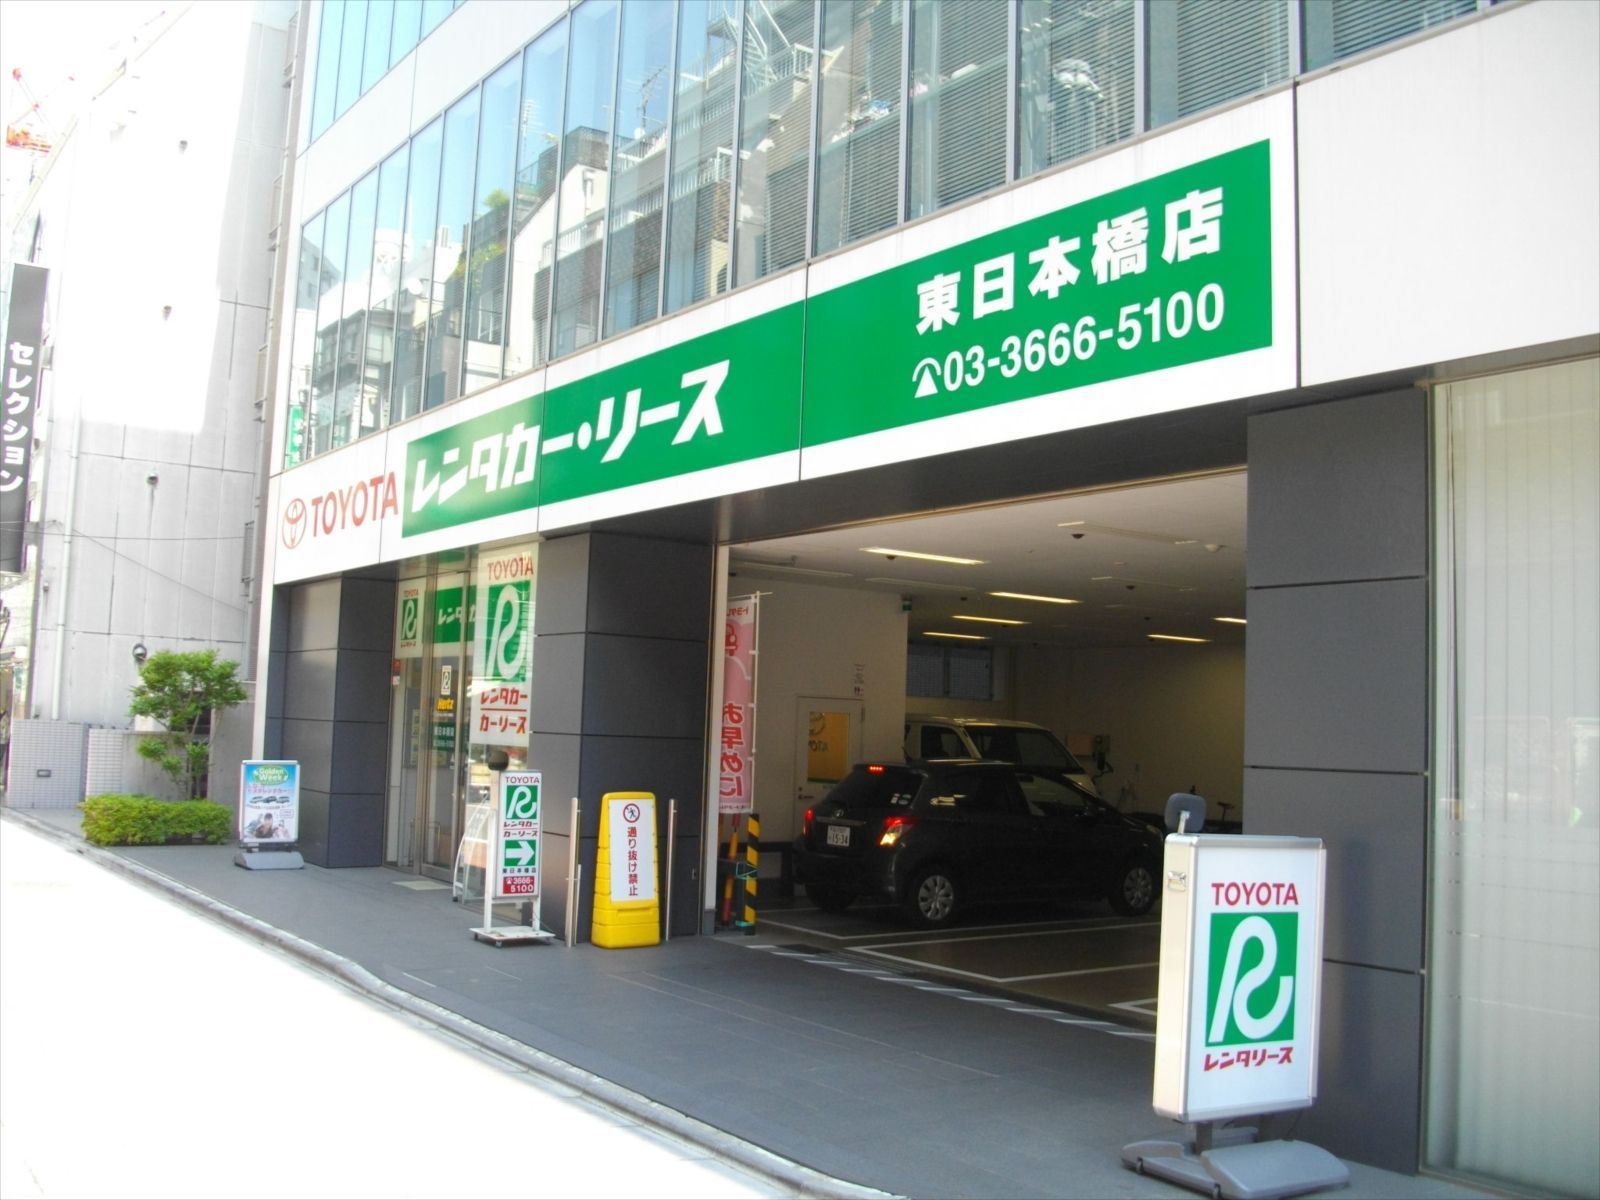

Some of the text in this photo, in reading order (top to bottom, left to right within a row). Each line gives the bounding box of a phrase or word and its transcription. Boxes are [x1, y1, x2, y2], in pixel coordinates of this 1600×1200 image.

[915, 186, 1224, 336] 東日本橋店
[943, 282, 1225, 392] 03-3666-5100
[0, 341, 35, 492] セレクション
[411, 359, 730, 513] レンタカー・リース
[311, 471, 398, 538] TOYOTA
[487, 555, 534, 581] TOYOTA
[480, 687, 528, 705] レンタカー
[479, 713, 527, 735] カーリース
[505, 776, 540, 784] TOYOTA
[503, 820, 539, 828] レンタカー
[503, 830, 538, 838] カーリース
[627, 826, 639, 897] 通り抜け禁止
[510, 884, 534, 893] 5100
[1211, 881, 1299, 906] TOYOTA
[1203, 1046, 1294, 1072] レンタリース
